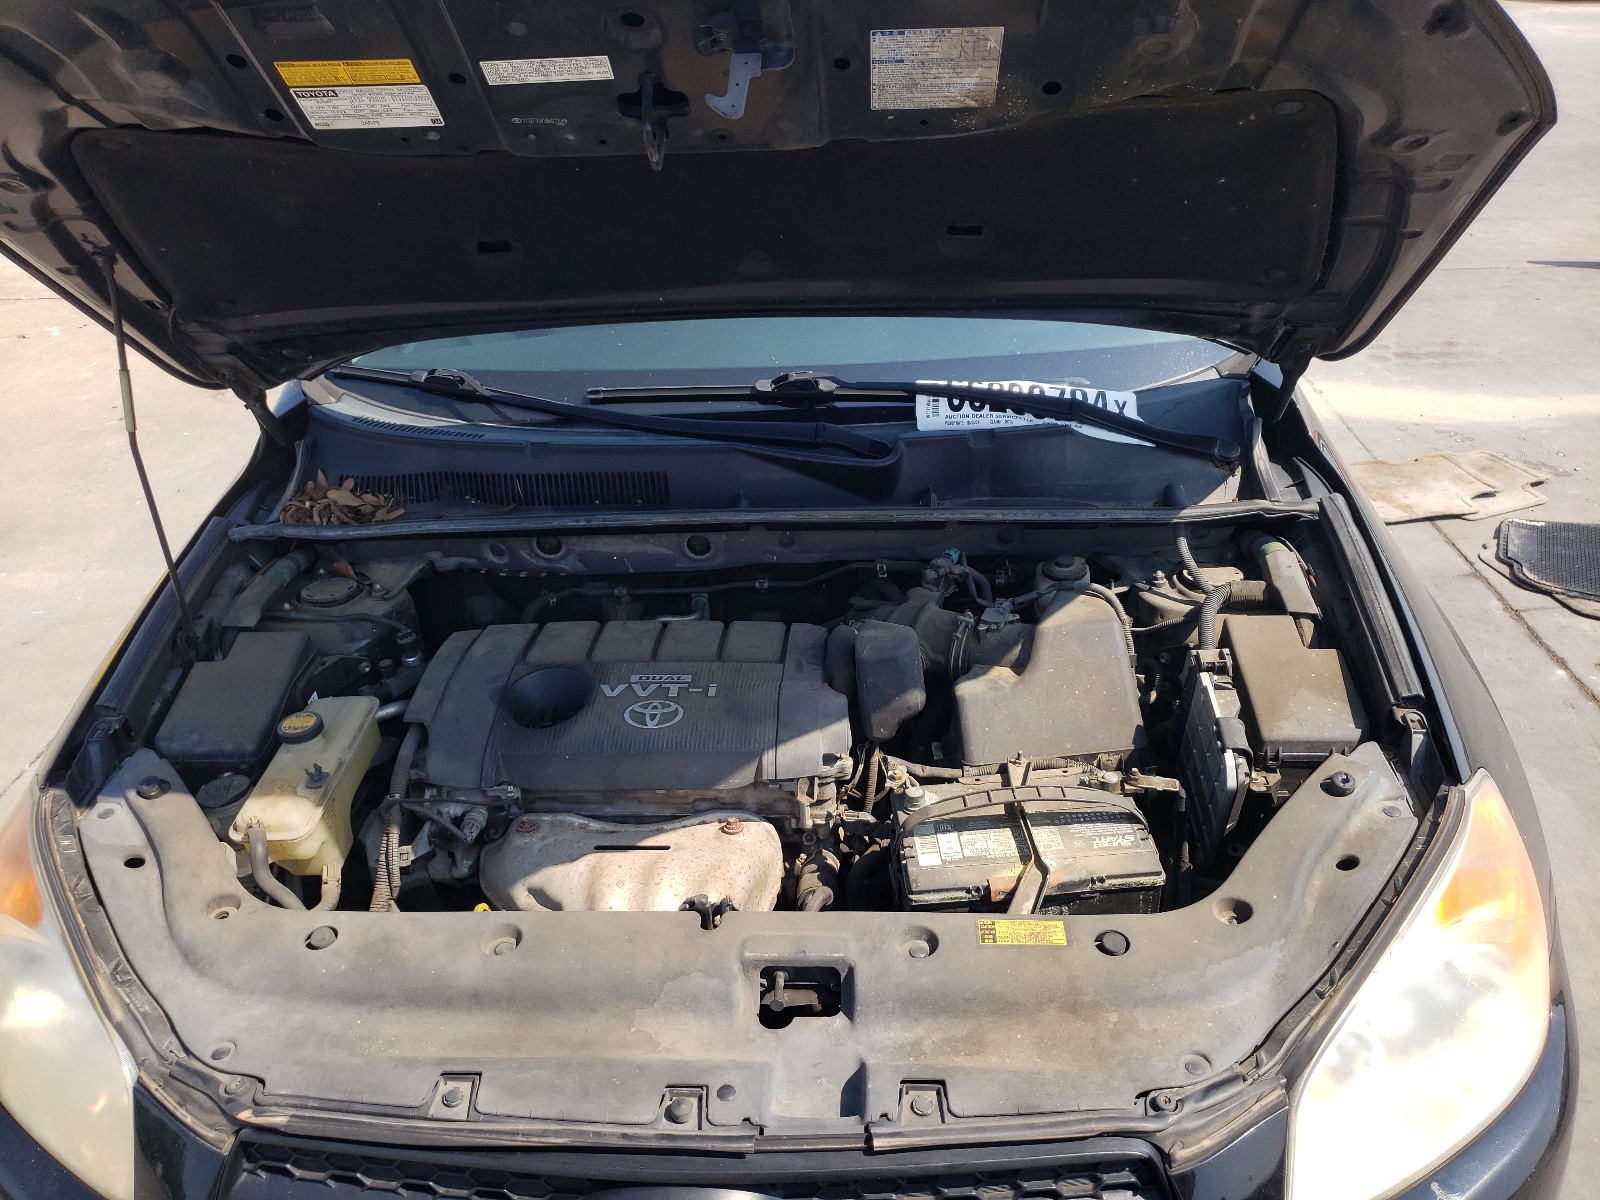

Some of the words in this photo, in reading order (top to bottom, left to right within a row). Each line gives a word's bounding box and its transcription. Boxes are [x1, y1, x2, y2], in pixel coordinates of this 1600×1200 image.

[600, 683, 718, 697] VVT-i
[1091, 833, 1135, 843] START
[1093, 841, 1132, 849] SUPER
